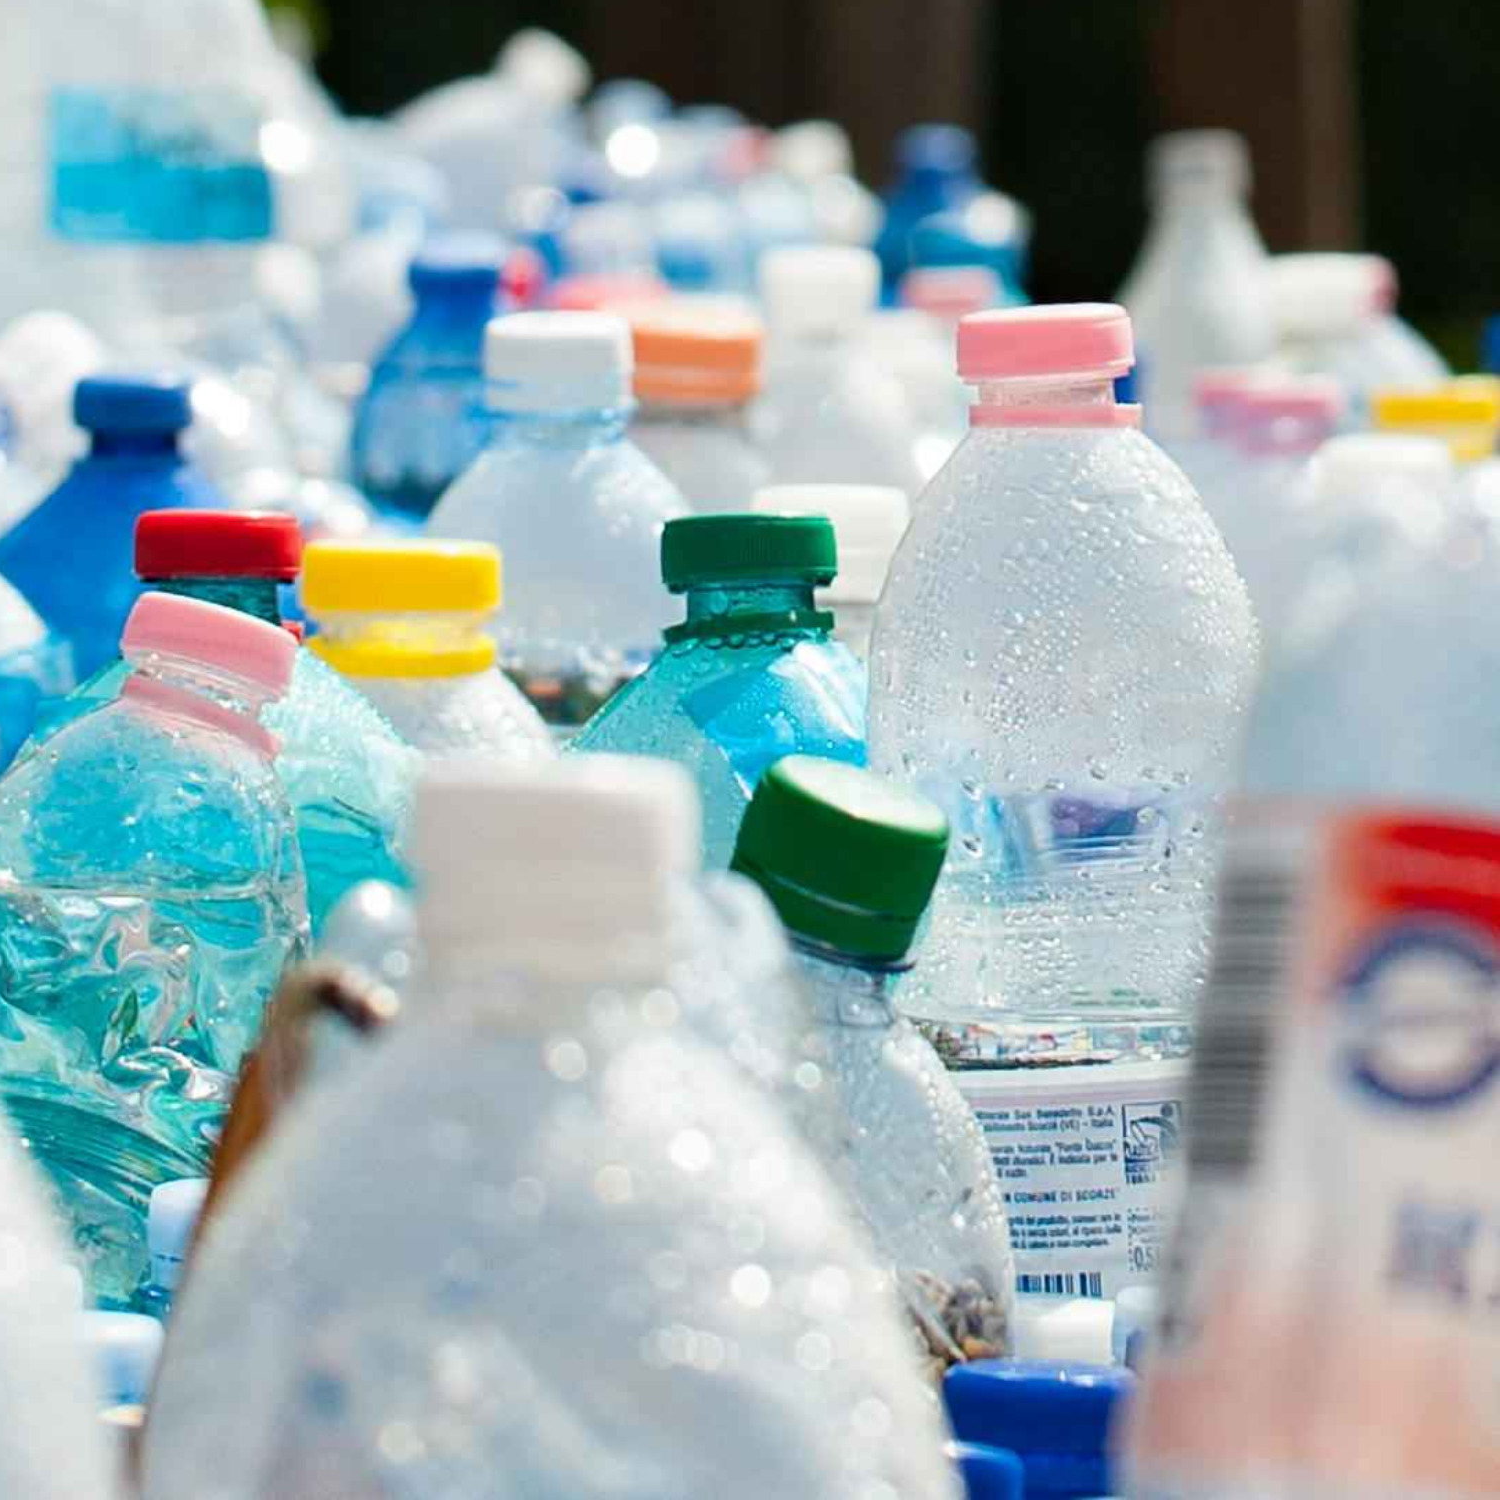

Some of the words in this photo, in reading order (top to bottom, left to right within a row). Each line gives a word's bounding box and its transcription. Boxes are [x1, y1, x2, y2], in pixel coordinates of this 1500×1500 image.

[1059, 1119, 1080, 1132] (VE)
[1014, 1190, 1056, 1203] COMUNE
[1060, 1190, 1073, 1202] DI
